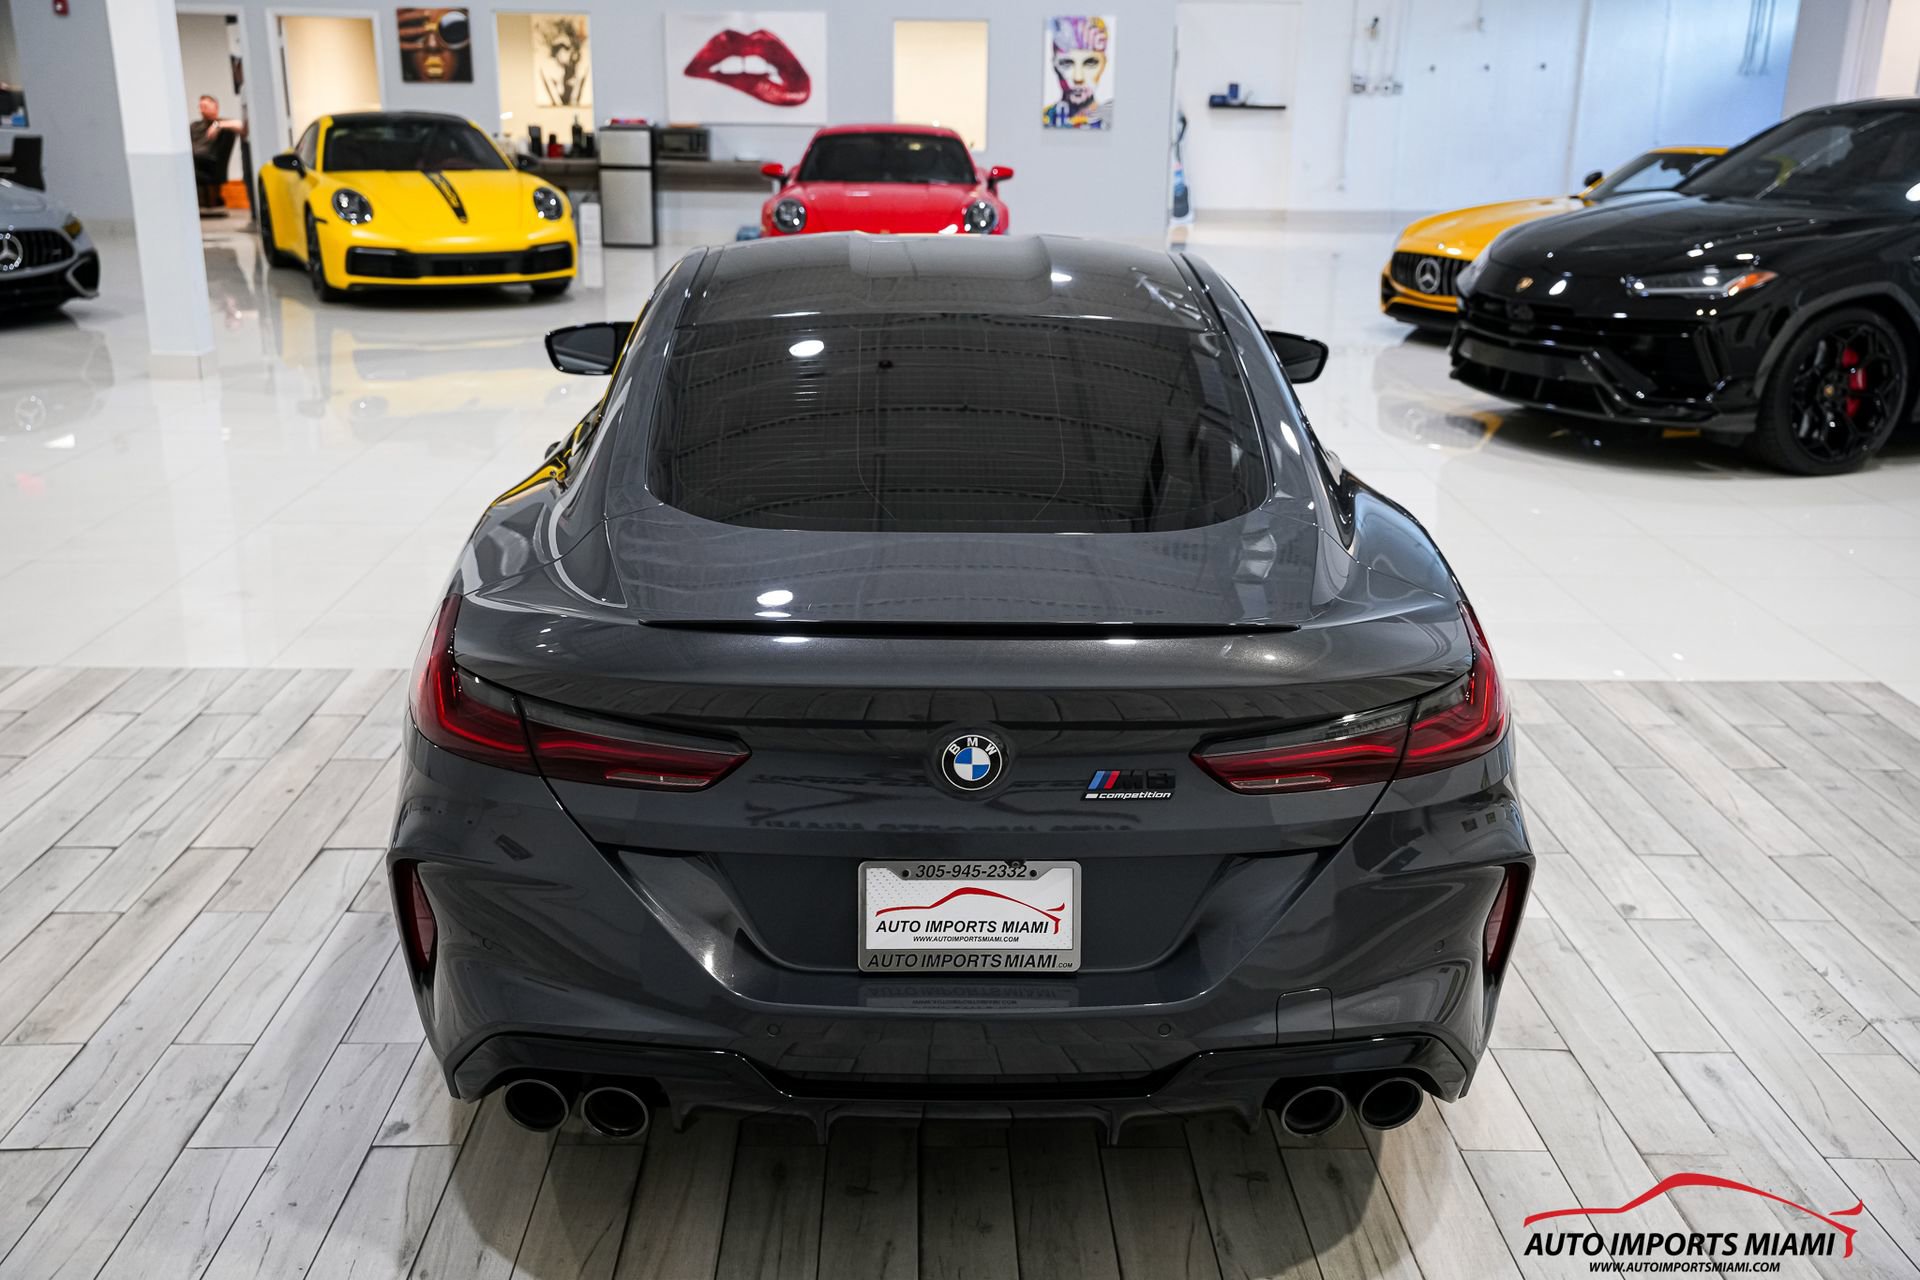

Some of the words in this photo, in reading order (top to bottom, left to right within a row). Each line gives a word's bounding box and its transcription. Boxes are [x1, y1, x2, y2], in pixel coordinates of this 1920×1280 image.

[949, 737, 997, 756] BMW
[1098, 791, 1172, 800] competition
[915, 864, 1028, 878] 305-945-2332
[876, 920, 922, 933] AUTO
[925, 920, 997, 933] IMPORTS
[1001, 921, 1049, 934] MIAMI
[867, 954, 918, 968] AUTO
[921, 953, 1002, 968] IMPORTS
